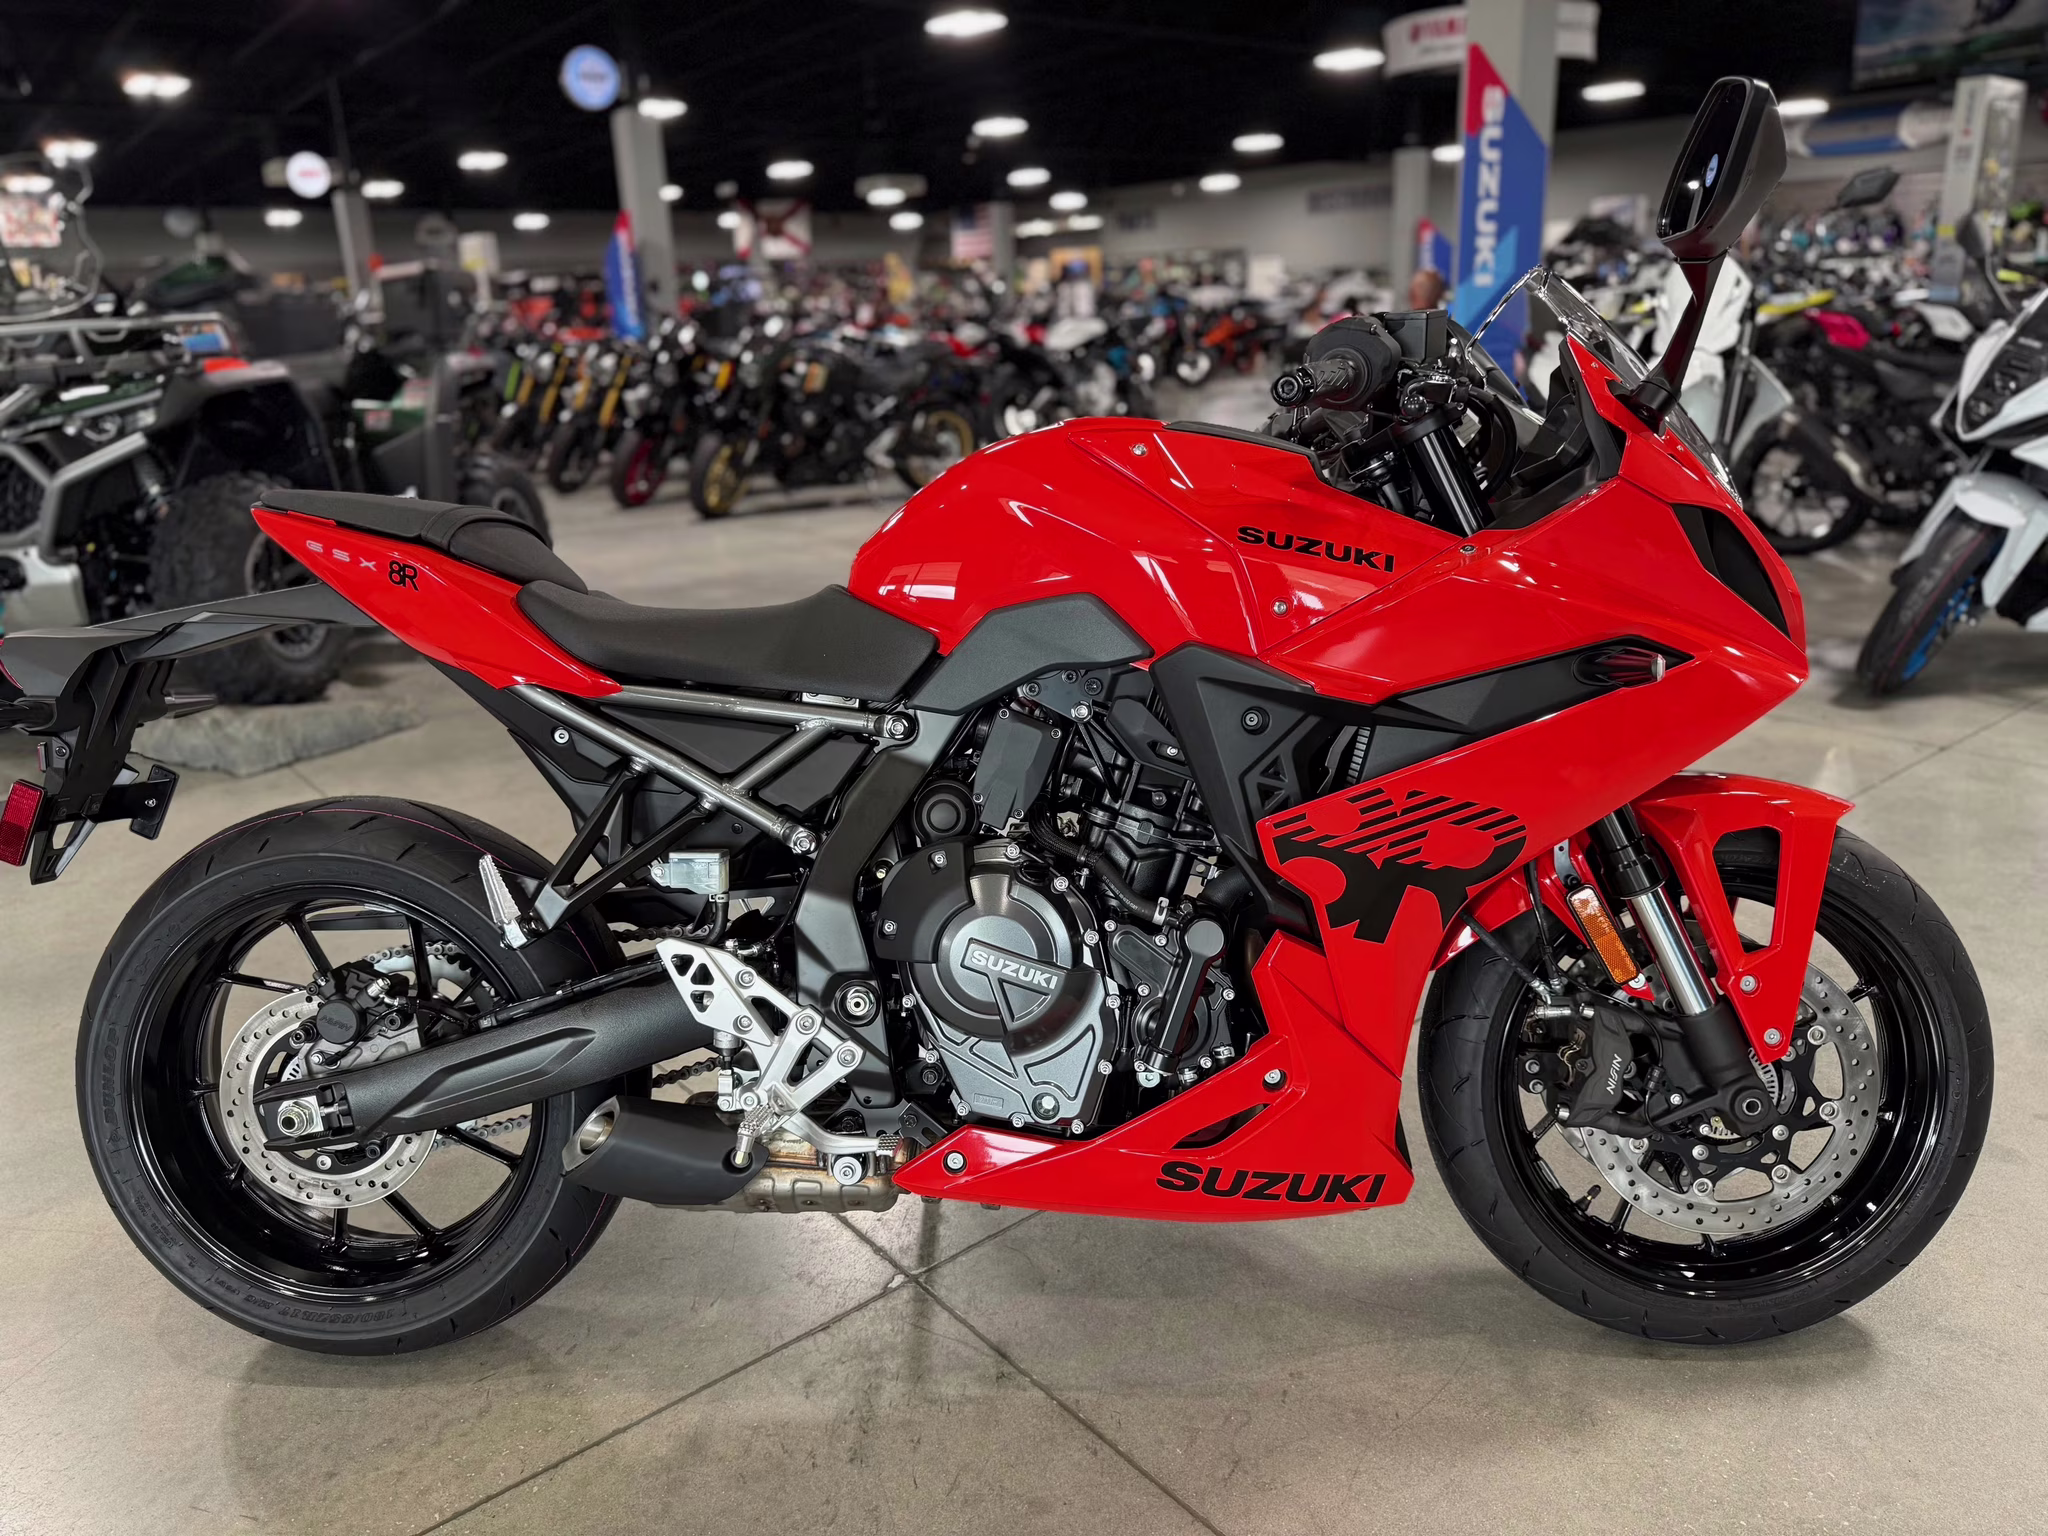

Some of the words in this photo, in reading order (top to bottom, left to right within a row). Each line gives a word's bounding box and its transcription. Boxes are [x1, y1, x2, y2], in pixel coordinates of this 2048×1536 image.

[1473, 84, 1506, 288] SUZUKI
[1237, 525, 1395, 573] SUZUKI
[388, 560, 419, 591] 8R
[970, 949, 1058, 990] SUZUKI
[102, 1025, 121, 1126] DUNLOP
[1156, 1160, 1386, 1204] SUZUKI
